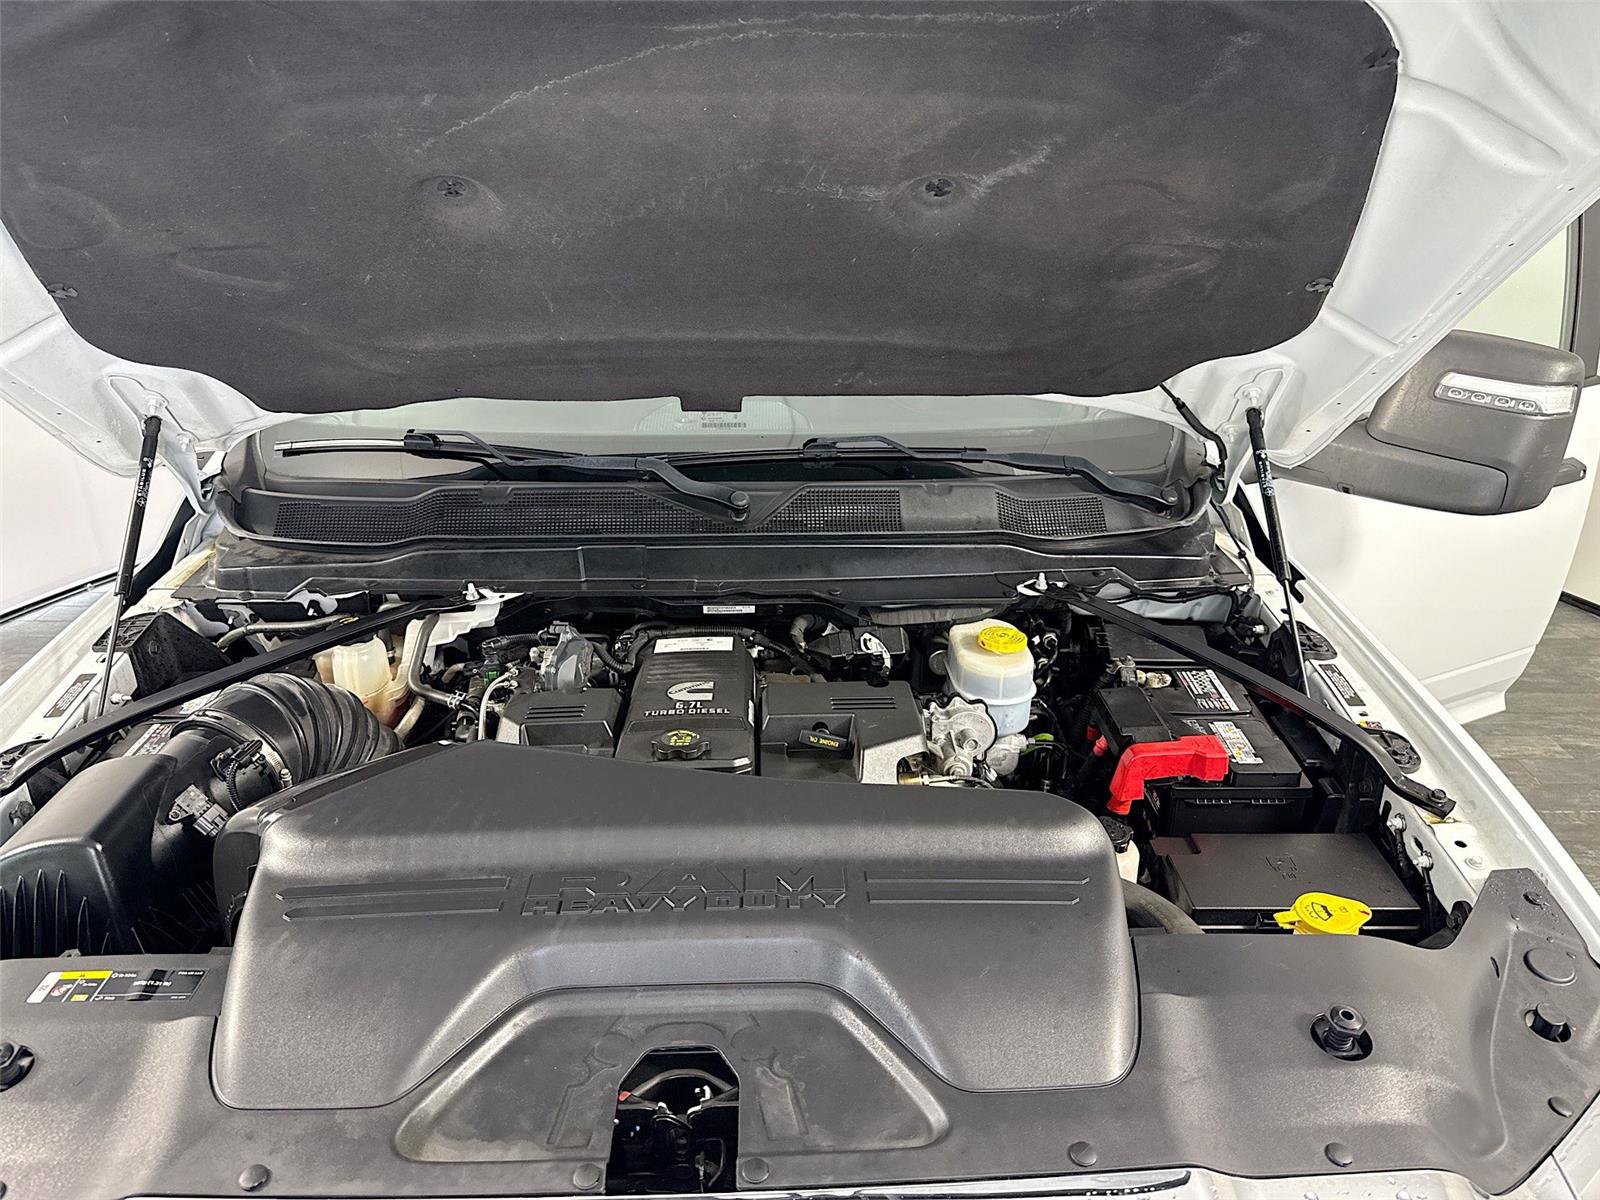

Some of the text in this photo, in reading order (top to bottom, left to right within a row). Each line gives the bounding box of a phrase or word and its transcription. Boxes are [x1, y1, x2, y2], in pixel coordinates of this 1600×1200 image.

[644, 709, 685, 717] TURBO
[675, 701, 703, 709] 6.7L
[526, 867, 847, 899] RAM
[521, 891, 847, 916] HEAVY DUTY
